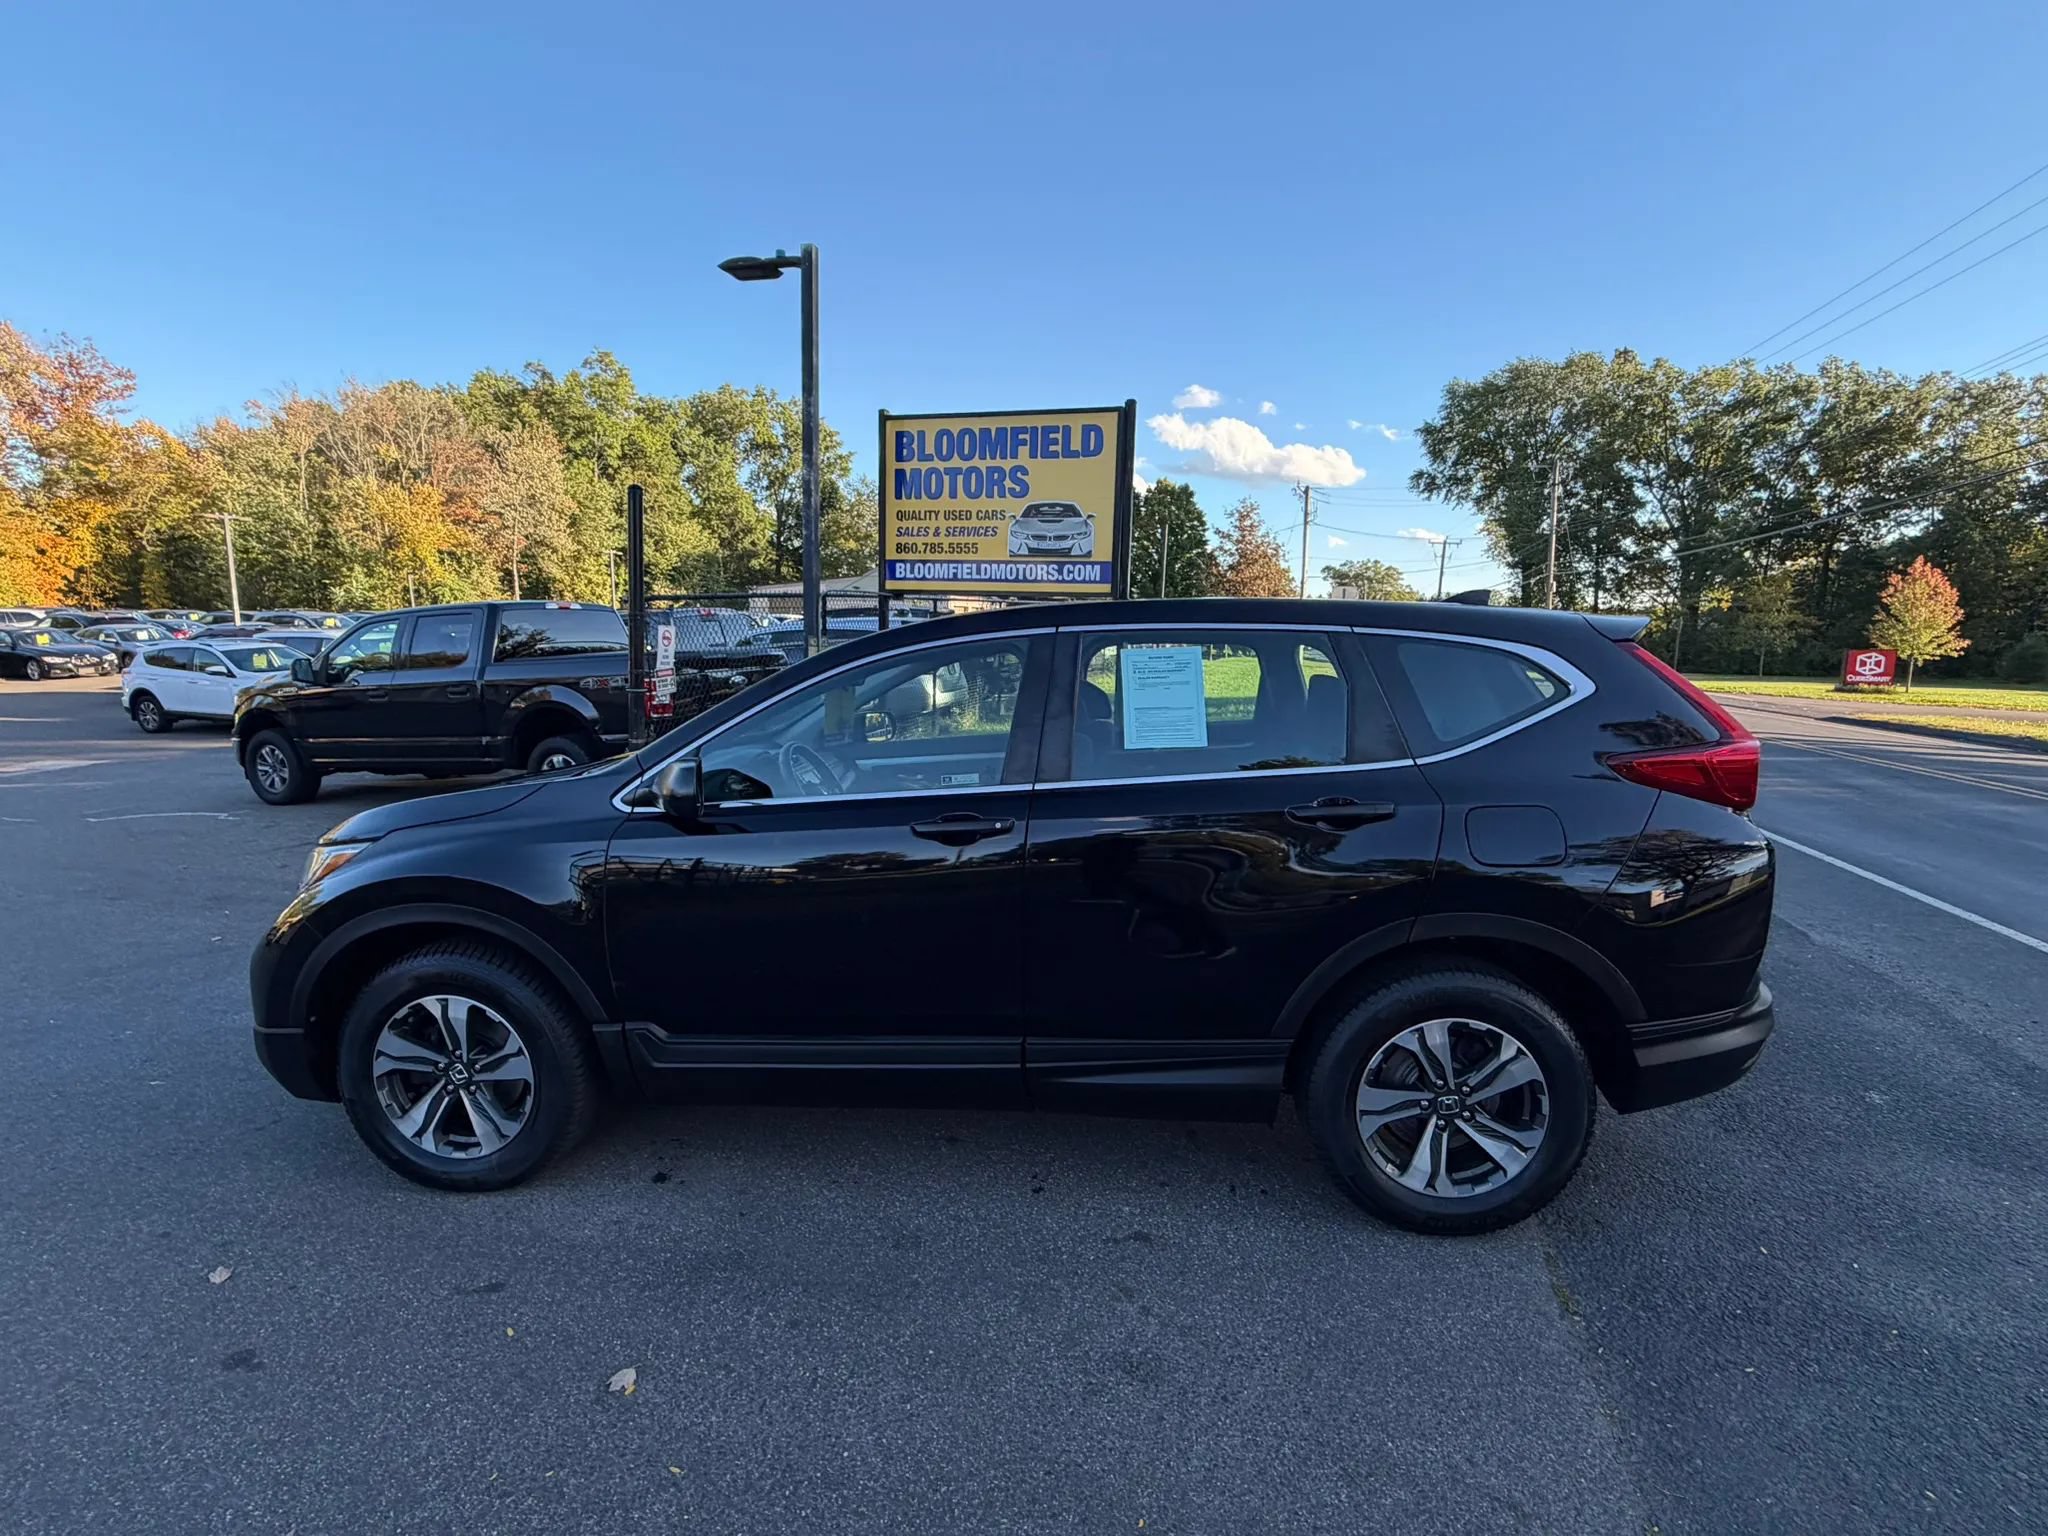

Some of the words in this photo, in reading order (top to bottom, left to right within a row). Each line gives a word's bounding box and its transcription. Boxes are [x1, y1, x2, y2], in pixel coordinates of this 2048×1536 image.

[895, 424, 1104, 462] BLOOMFIELD
[895, 465, 1030, 500] MOTORS
[896, 510, 940, 521] QUALITY
[943, 510, 972, 521] USED
[976, 510, 1006, 521] CARS
[896, 526, 930, 537] SALES
[933, 526, 942, 537] &
[944, 526, 999, 537] SERVICES
[896, 542, 979, 554] 860.785.5555
[896, 562, 1100, 581] BLOOMFIELDMOTORS.COM
